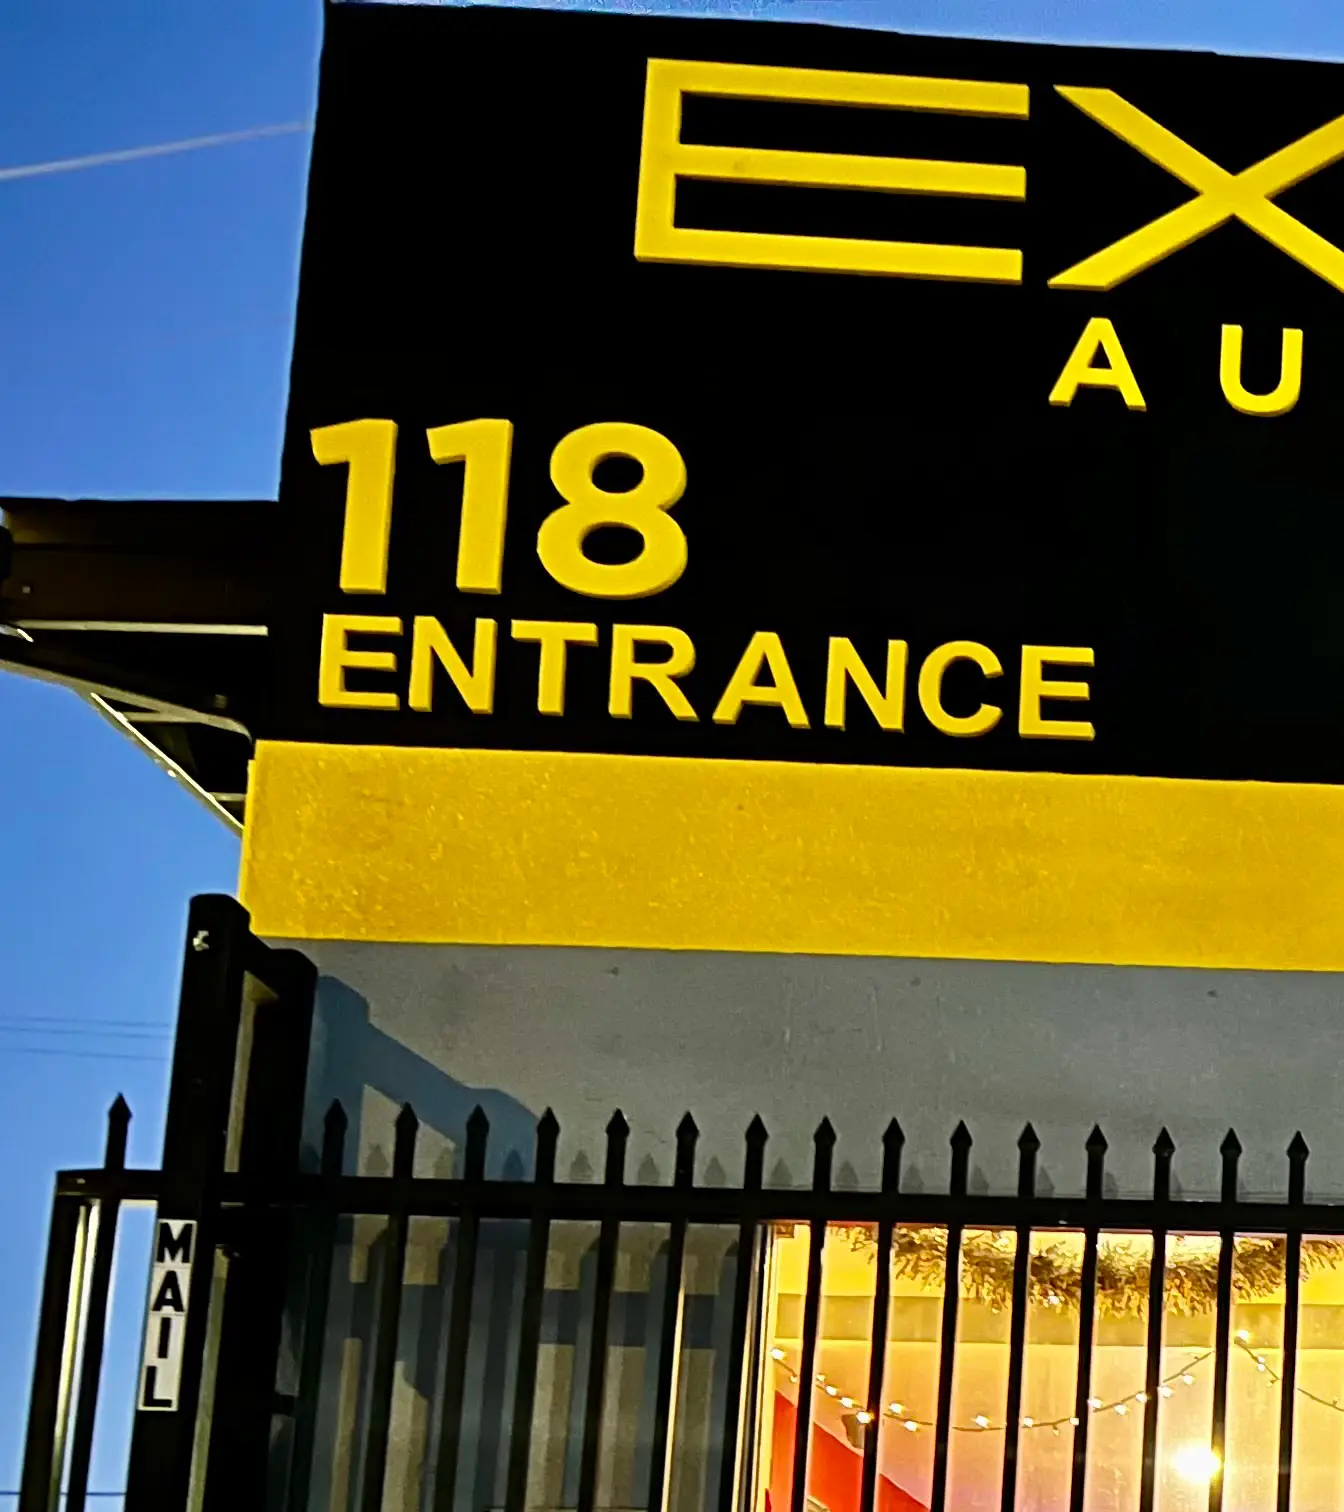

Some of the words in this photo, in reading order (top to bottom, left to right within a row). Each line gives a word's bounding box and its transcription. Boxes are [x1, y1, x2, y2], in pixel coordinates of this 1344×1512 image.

[308, 417, 690, 601] 118
[316, 612, 1097, 742] ENTRANCE
[143, 1222, 194, 1408] MAIL
